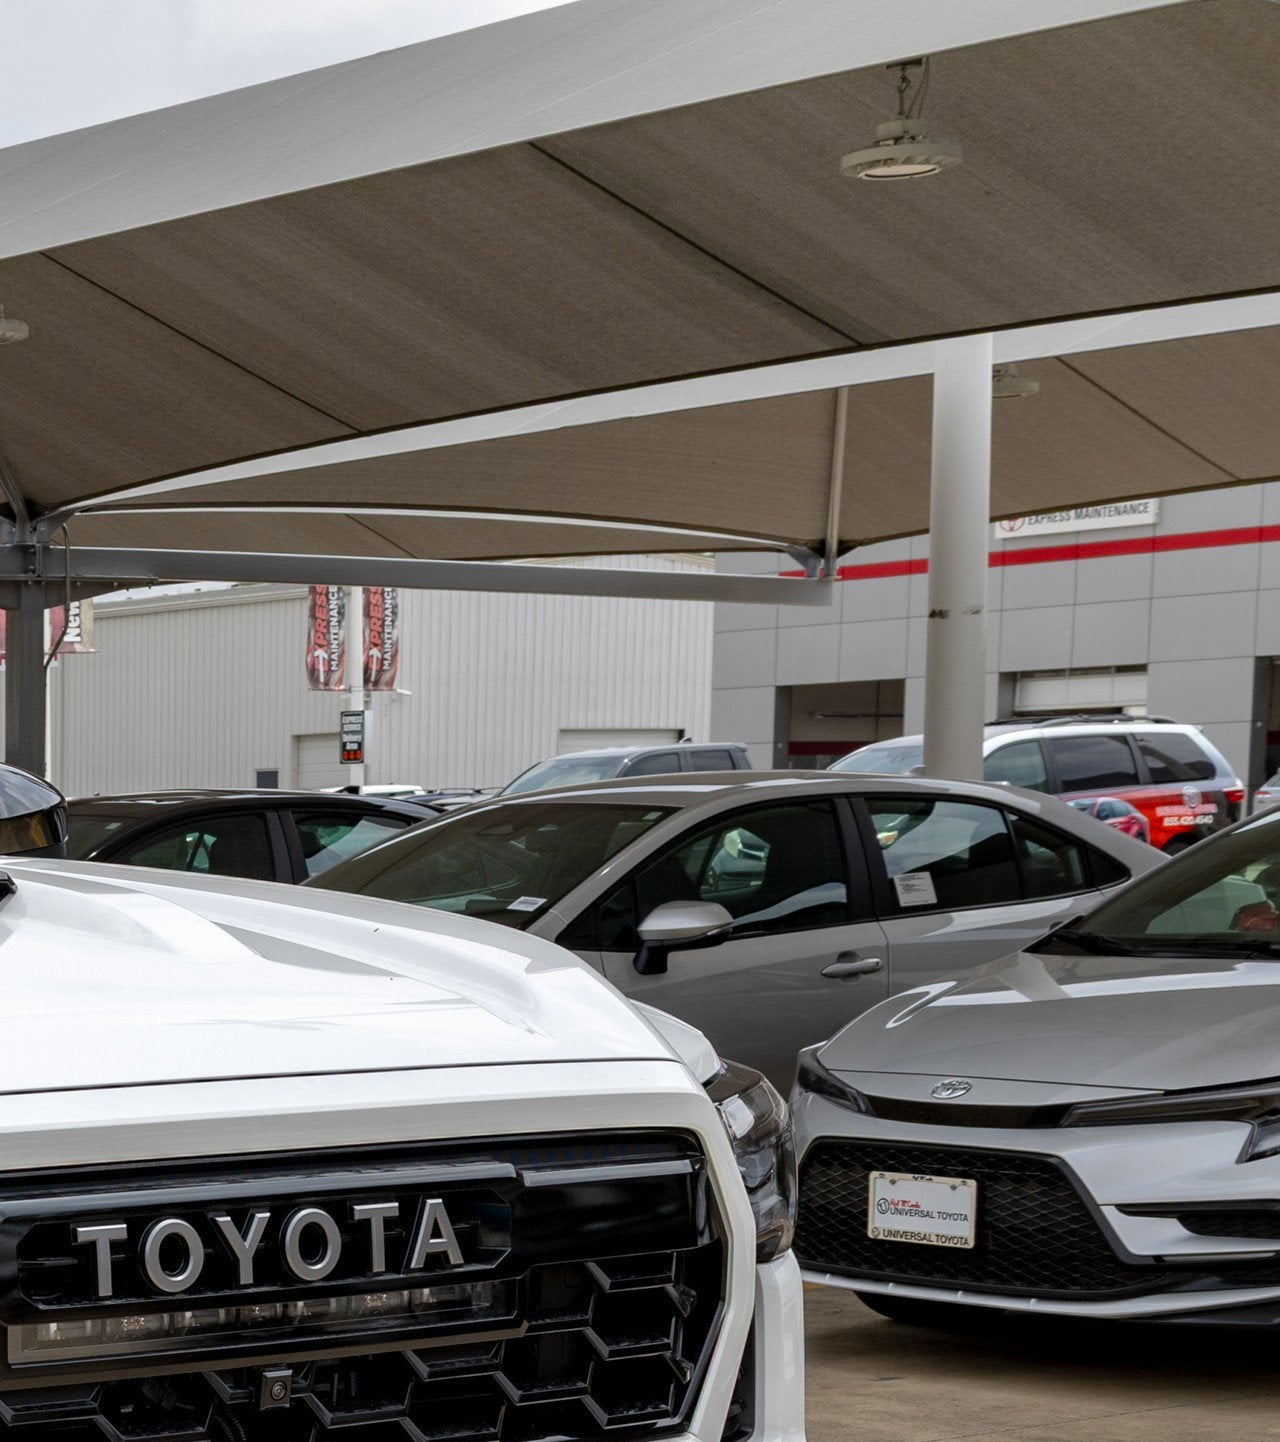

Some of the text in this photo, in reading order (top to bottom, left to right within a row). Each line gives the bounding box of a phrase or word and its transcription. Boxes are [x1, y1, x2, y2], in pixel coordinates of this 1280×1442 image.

[1074, 501, 1150, 520] MAINTENANCE
[328, 584, 339, 671] MAINTENANCE
[890, 1207, 936, 1220] UNIVERSAL
[937, 1211, 969, 1223] TOYOTA
[882, 1228, 970, 1247] UNIVERSAL TOYOTA
[73, 1197, 465, 1298] TOYOTA
